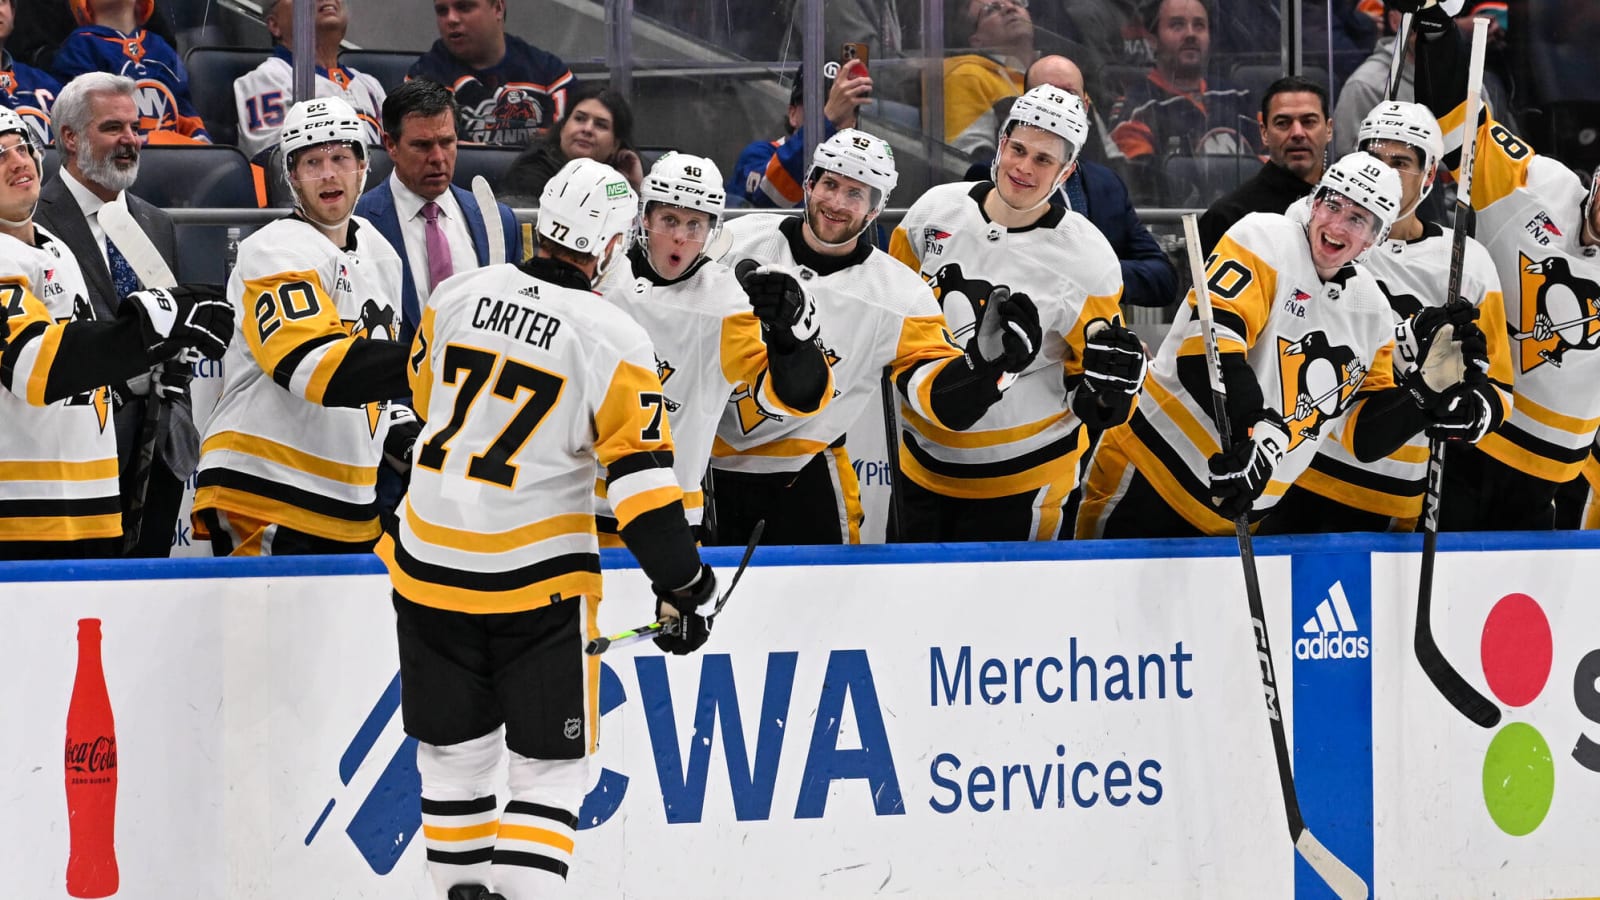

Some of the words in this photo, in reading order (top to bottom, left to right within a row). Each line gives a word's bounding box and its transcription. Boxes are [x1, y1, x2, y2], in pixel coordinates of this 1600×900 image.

[246, 91, 285, 132] 15
[304, 120, 335, 130] CCM
[1489, 125, 1530, 160] 8
[607, 182, 627, 196] MSA
[1349, 177, 1376, 194] CCM
[1362, 164, 1381, 178] 10
[674, 185, 705, 196] CCM
[550, 221, 570, 242] 77
[255, 280, 321, 346] 20
[471, 296, 561, 351] CARTER
[416, 342, 569, 491] 77
[1294, 631, 1370, 660] adidas
[929, 637, 1194, 707] Merchant
[1251, 617, 1281, 722] CCM
[66, 736, 117, 773] Coca-Cola
[928, 744, 1164, 815] Services
